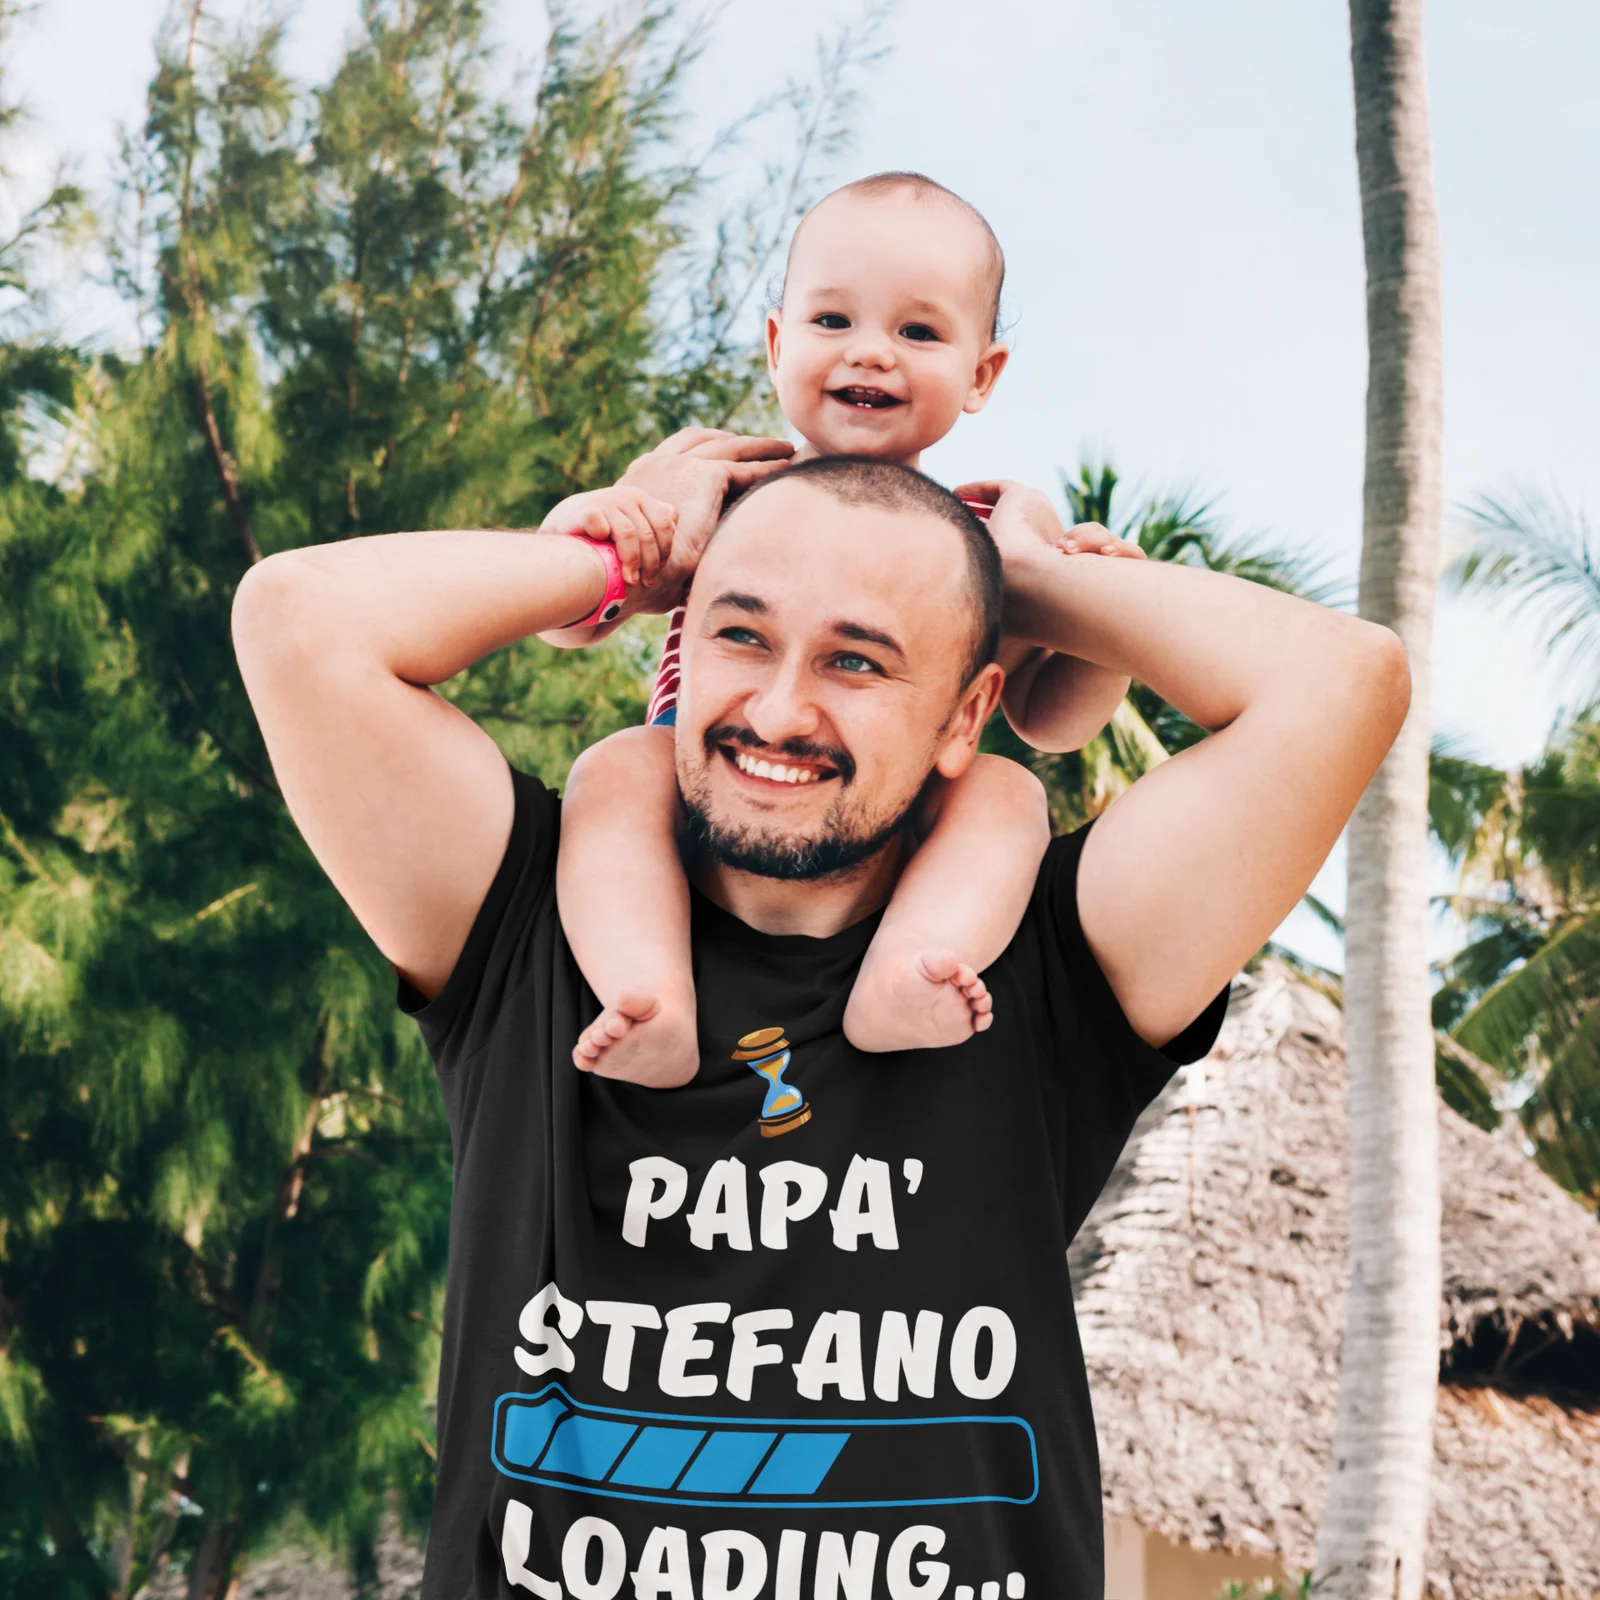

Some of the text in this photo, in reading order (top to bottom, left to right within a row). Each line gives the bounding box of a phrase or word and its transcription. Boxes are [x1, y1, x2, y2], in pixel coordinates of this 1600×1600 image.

[621, 1153, 924, 1252] PAPA'
[513, 1281, 1017, 1402] STEFANO
[501, 1498, 1026, 1600] LOADING...
